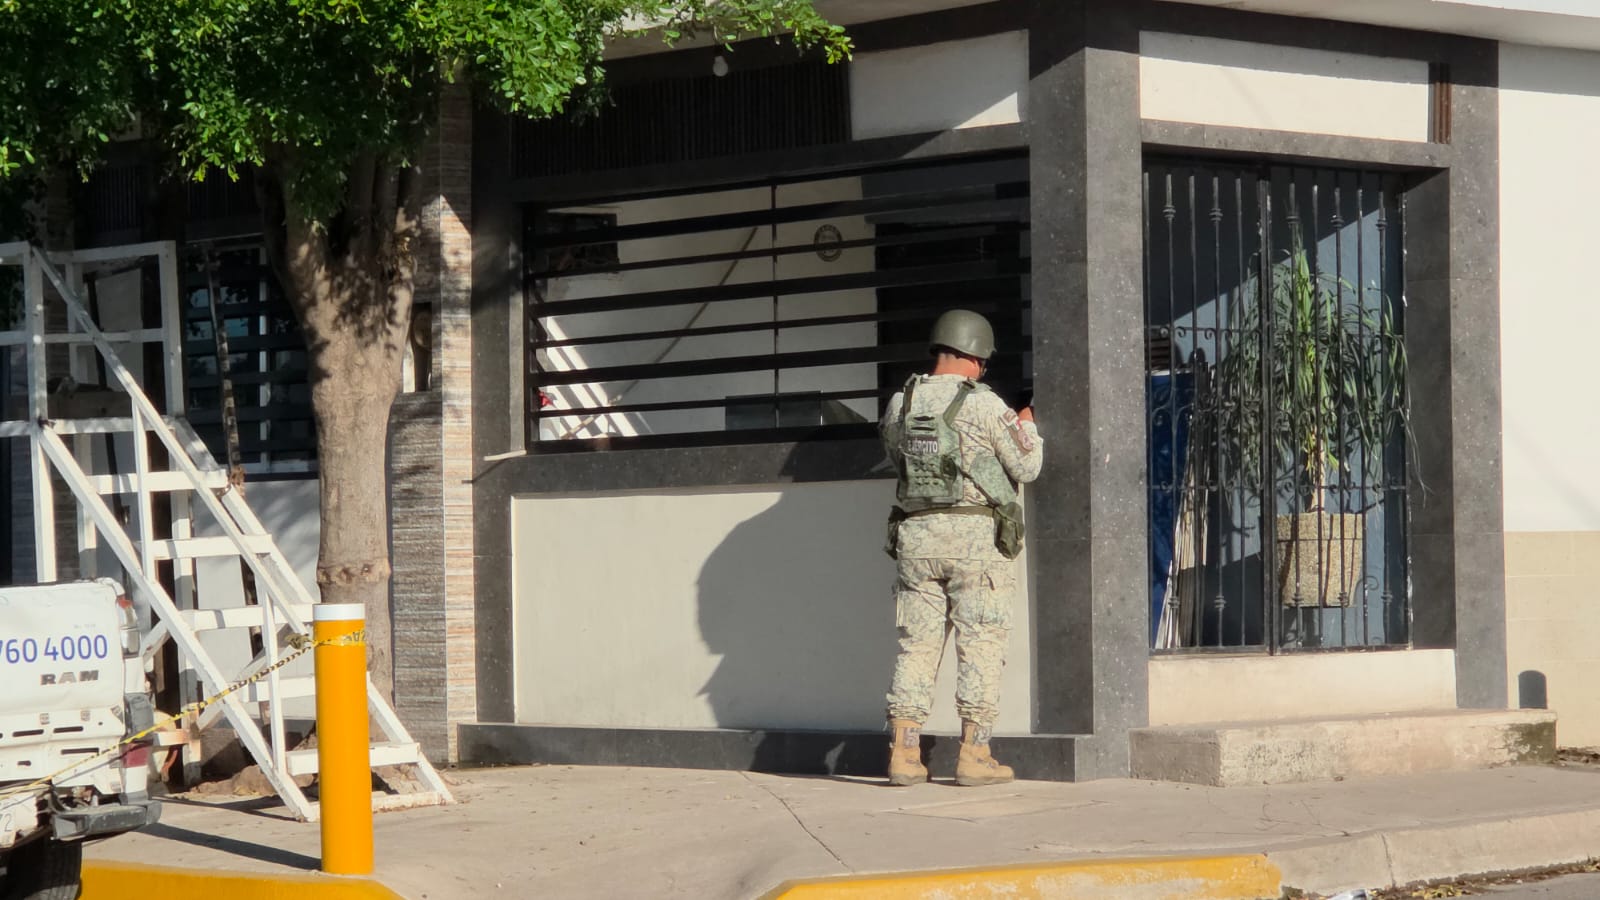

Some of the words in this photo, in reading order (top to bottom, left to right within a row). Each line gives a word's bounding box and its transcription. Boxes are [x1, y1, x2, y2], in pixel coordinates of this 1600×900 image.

[0, 638, 38, 663] 60
[44, 634, 108, 661] 4000
[41, 670, 99, 685] RAM
